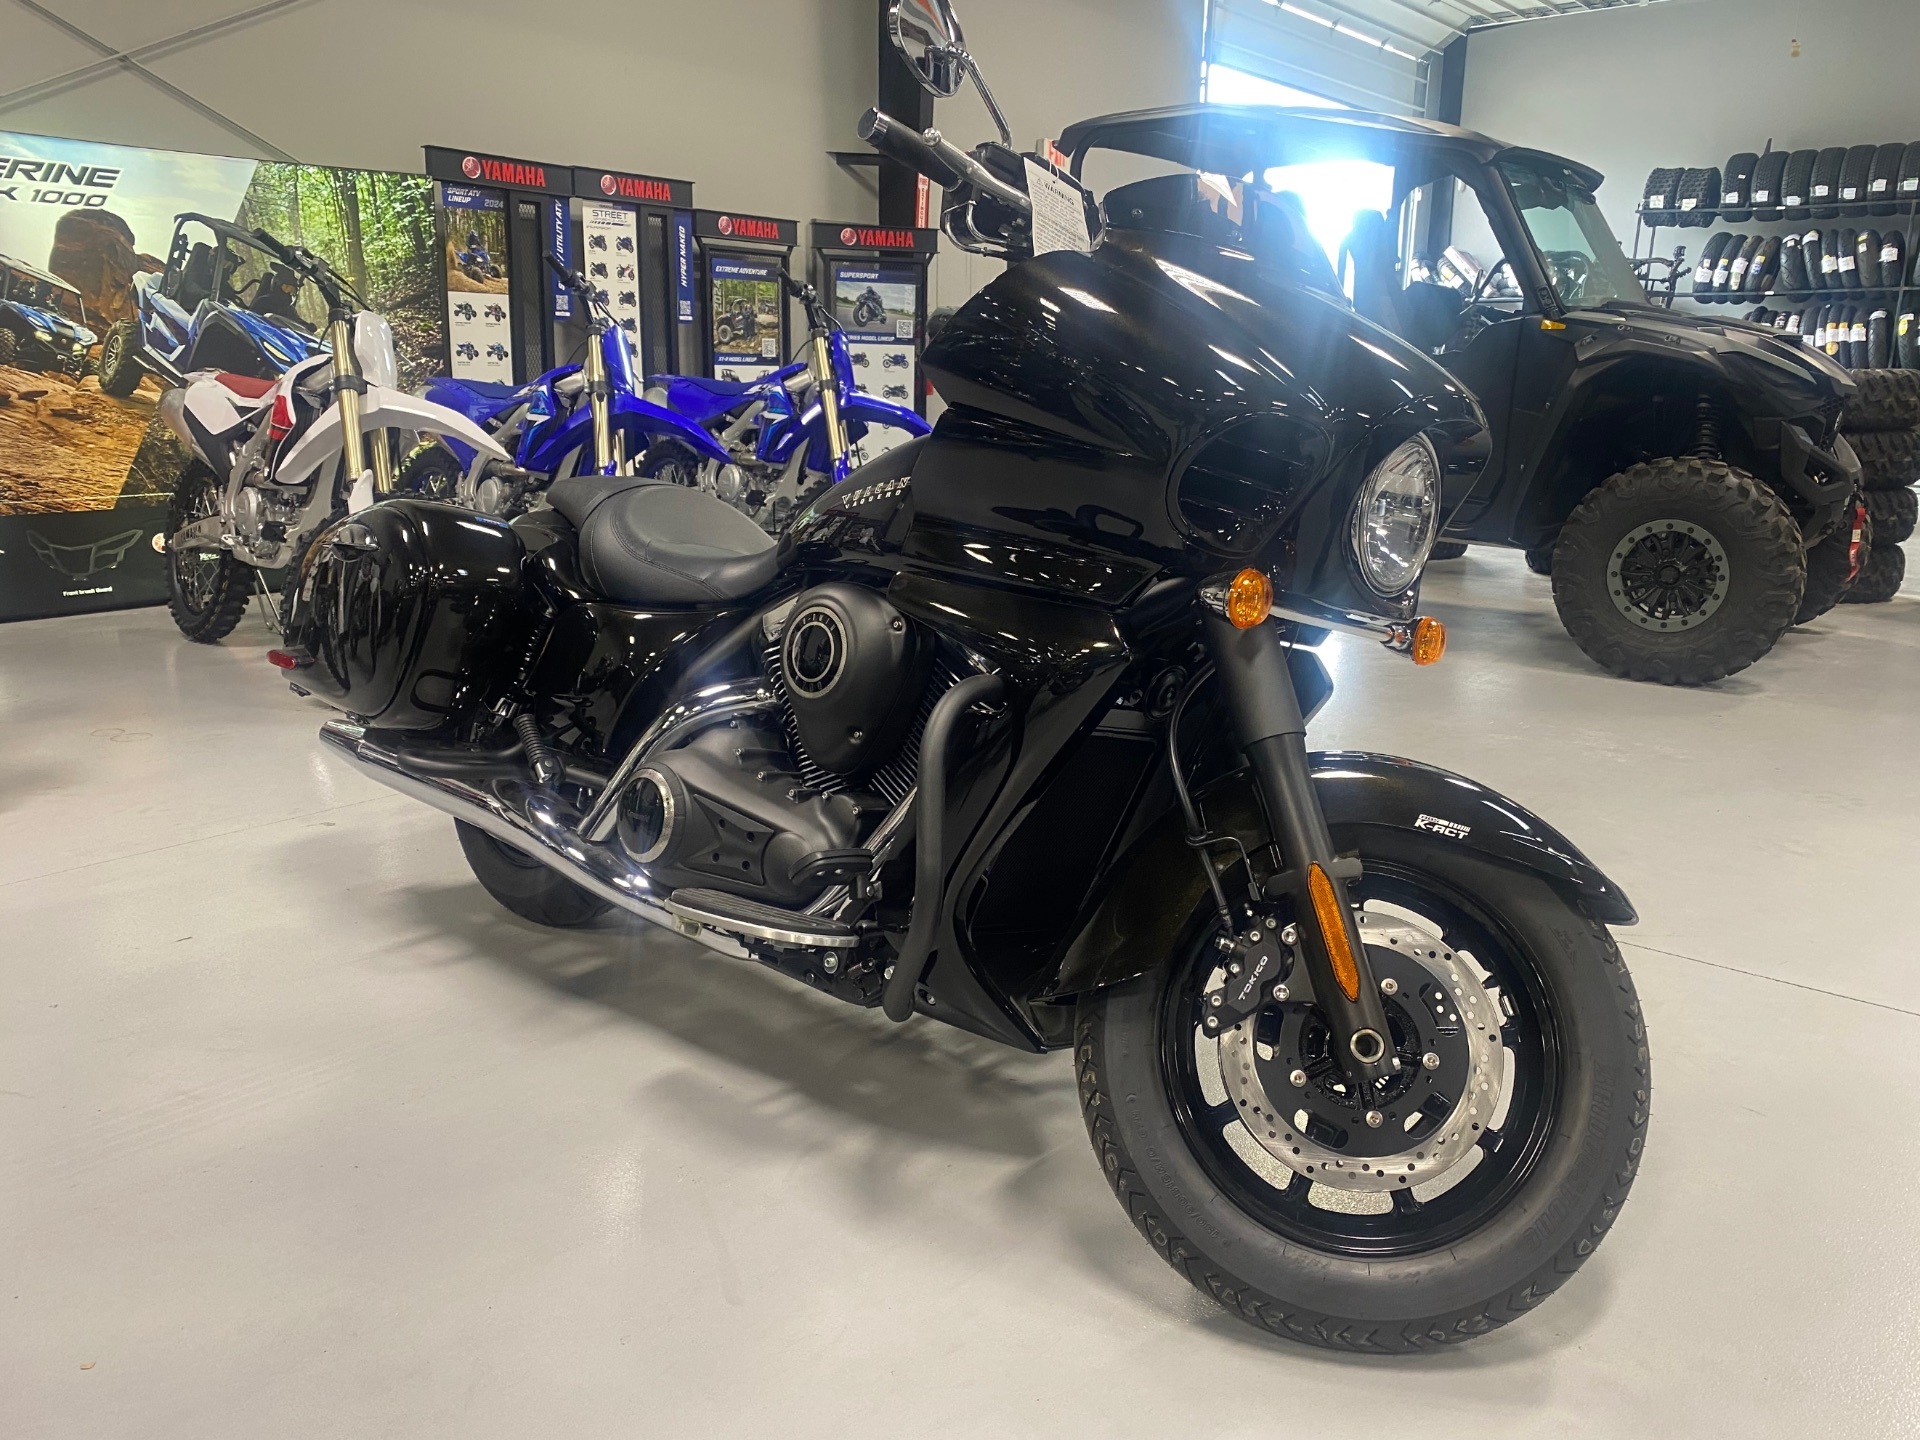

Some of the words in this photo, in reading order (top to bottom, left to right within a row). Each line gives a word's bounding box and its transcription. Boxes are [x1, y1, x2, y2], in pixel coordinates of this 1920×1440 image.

[481, 159, 546, 187] YAMAHA
[30, 189, 108, 207] 1000
[447, 187, 468, 196] SPORT
[468, 189, 481, 197] ATV
[617, 177, 671, 201] YAMAHA
[448, 195, 471, 203] LINEUP
[484, 199, 504, 208] 2024
[592, 209, 629, 220] STREET
[733, 218, 779, 239] YAMAHA
[857, 229, 914, 248] YAMAHA
[715, 265, 739, 274] EXTREME
[739, 268, 768, 276] ADVENTURE
[840, 271, 879, 279] SUPERSPORT
[842, 477, 911, 504] VULCAN
[1414, 818, 1469, 840] K-ACT
[1238, 955, 1268, 1000] TOKICO
